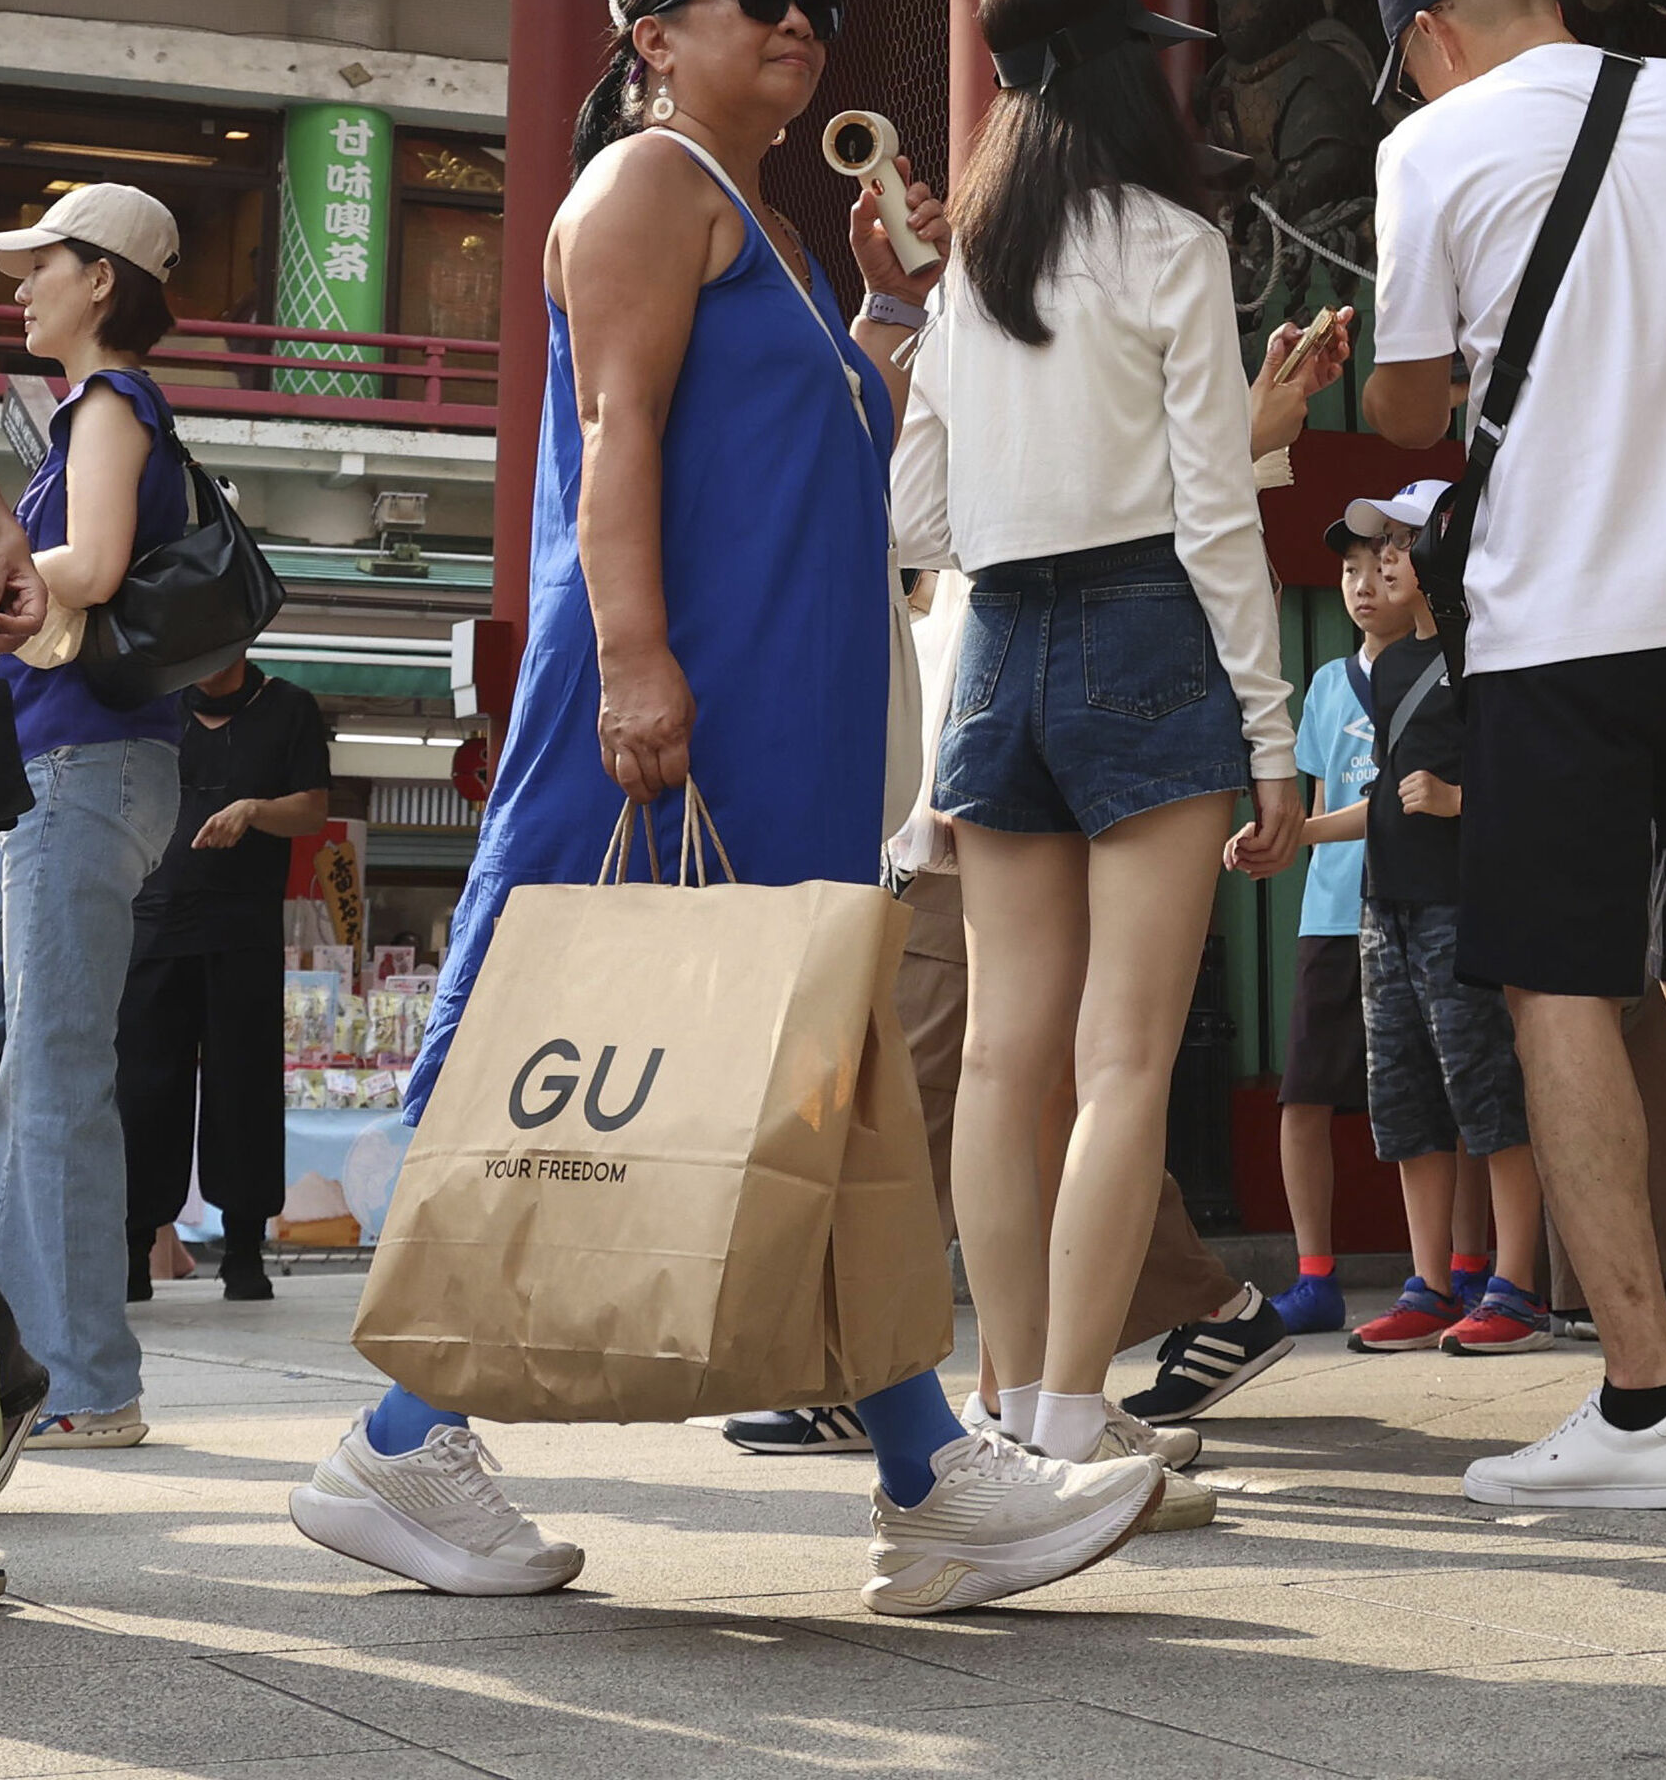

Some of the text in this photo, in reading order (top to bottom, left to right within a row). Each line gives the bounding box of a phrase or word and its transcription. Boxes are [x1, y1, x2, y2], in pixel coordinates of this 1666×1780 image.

[323, 118, 375, 284] 甘味喫茶
[1341, 772, 1354, 784] IN
[508, 1038, 665, 1132] GU
[484, 1158, 627, 1183] YOUR FREEDOM
